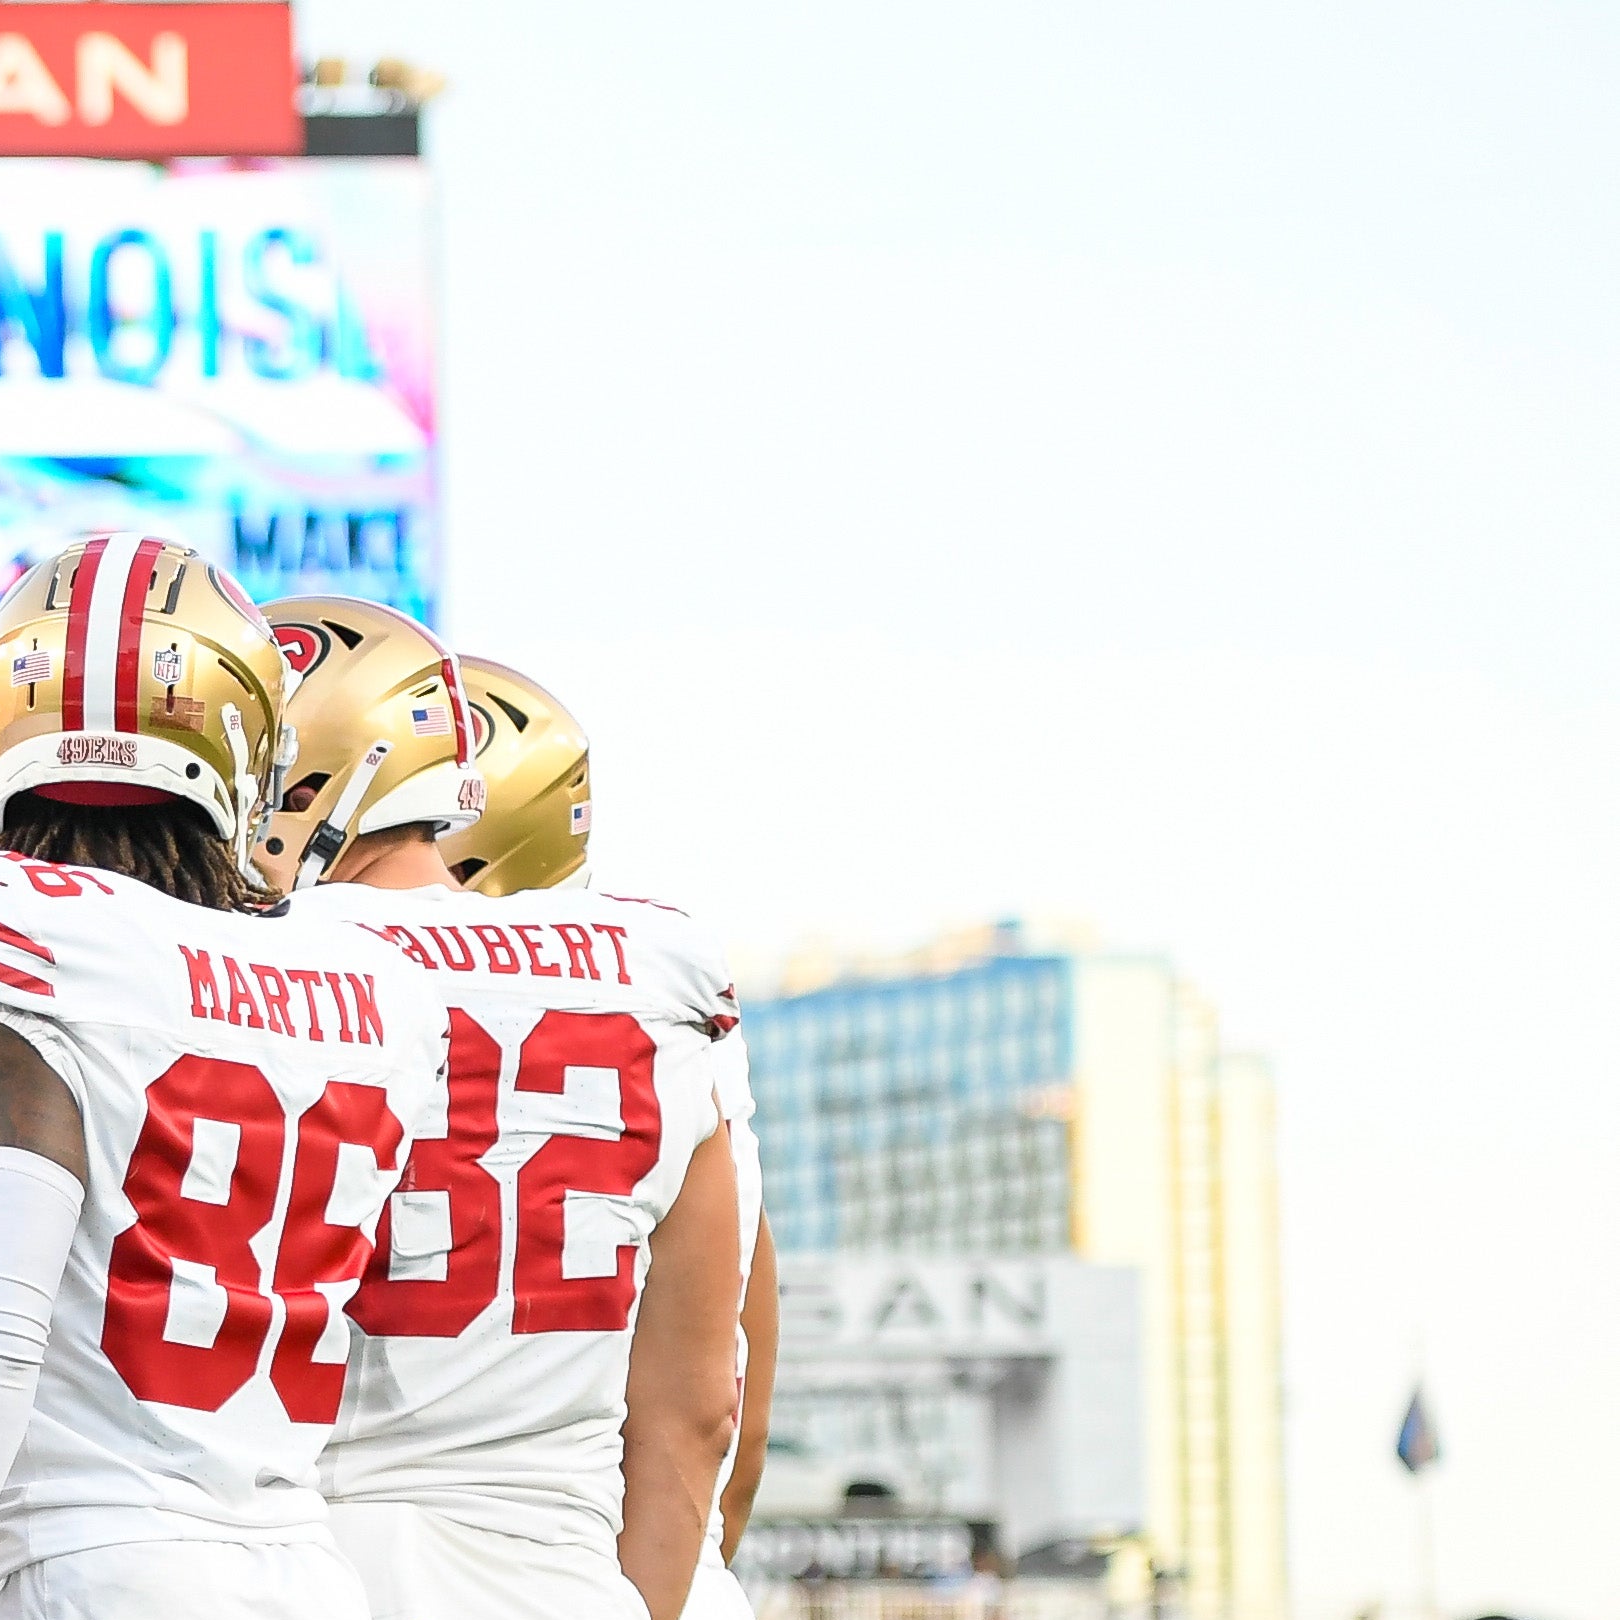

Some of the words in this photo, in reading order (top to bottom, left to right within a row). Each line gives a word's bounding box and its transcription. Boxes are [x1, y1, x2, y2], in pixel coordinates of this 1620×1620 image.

[56, 736, 138, 767] 49ERS
[177, 944, 385, 1048] MARTIN
[374, 922, 632, 986] AUBERT
[343, 1006, 661, 1339] 82
[100, 1053, 405, 1426] 86
